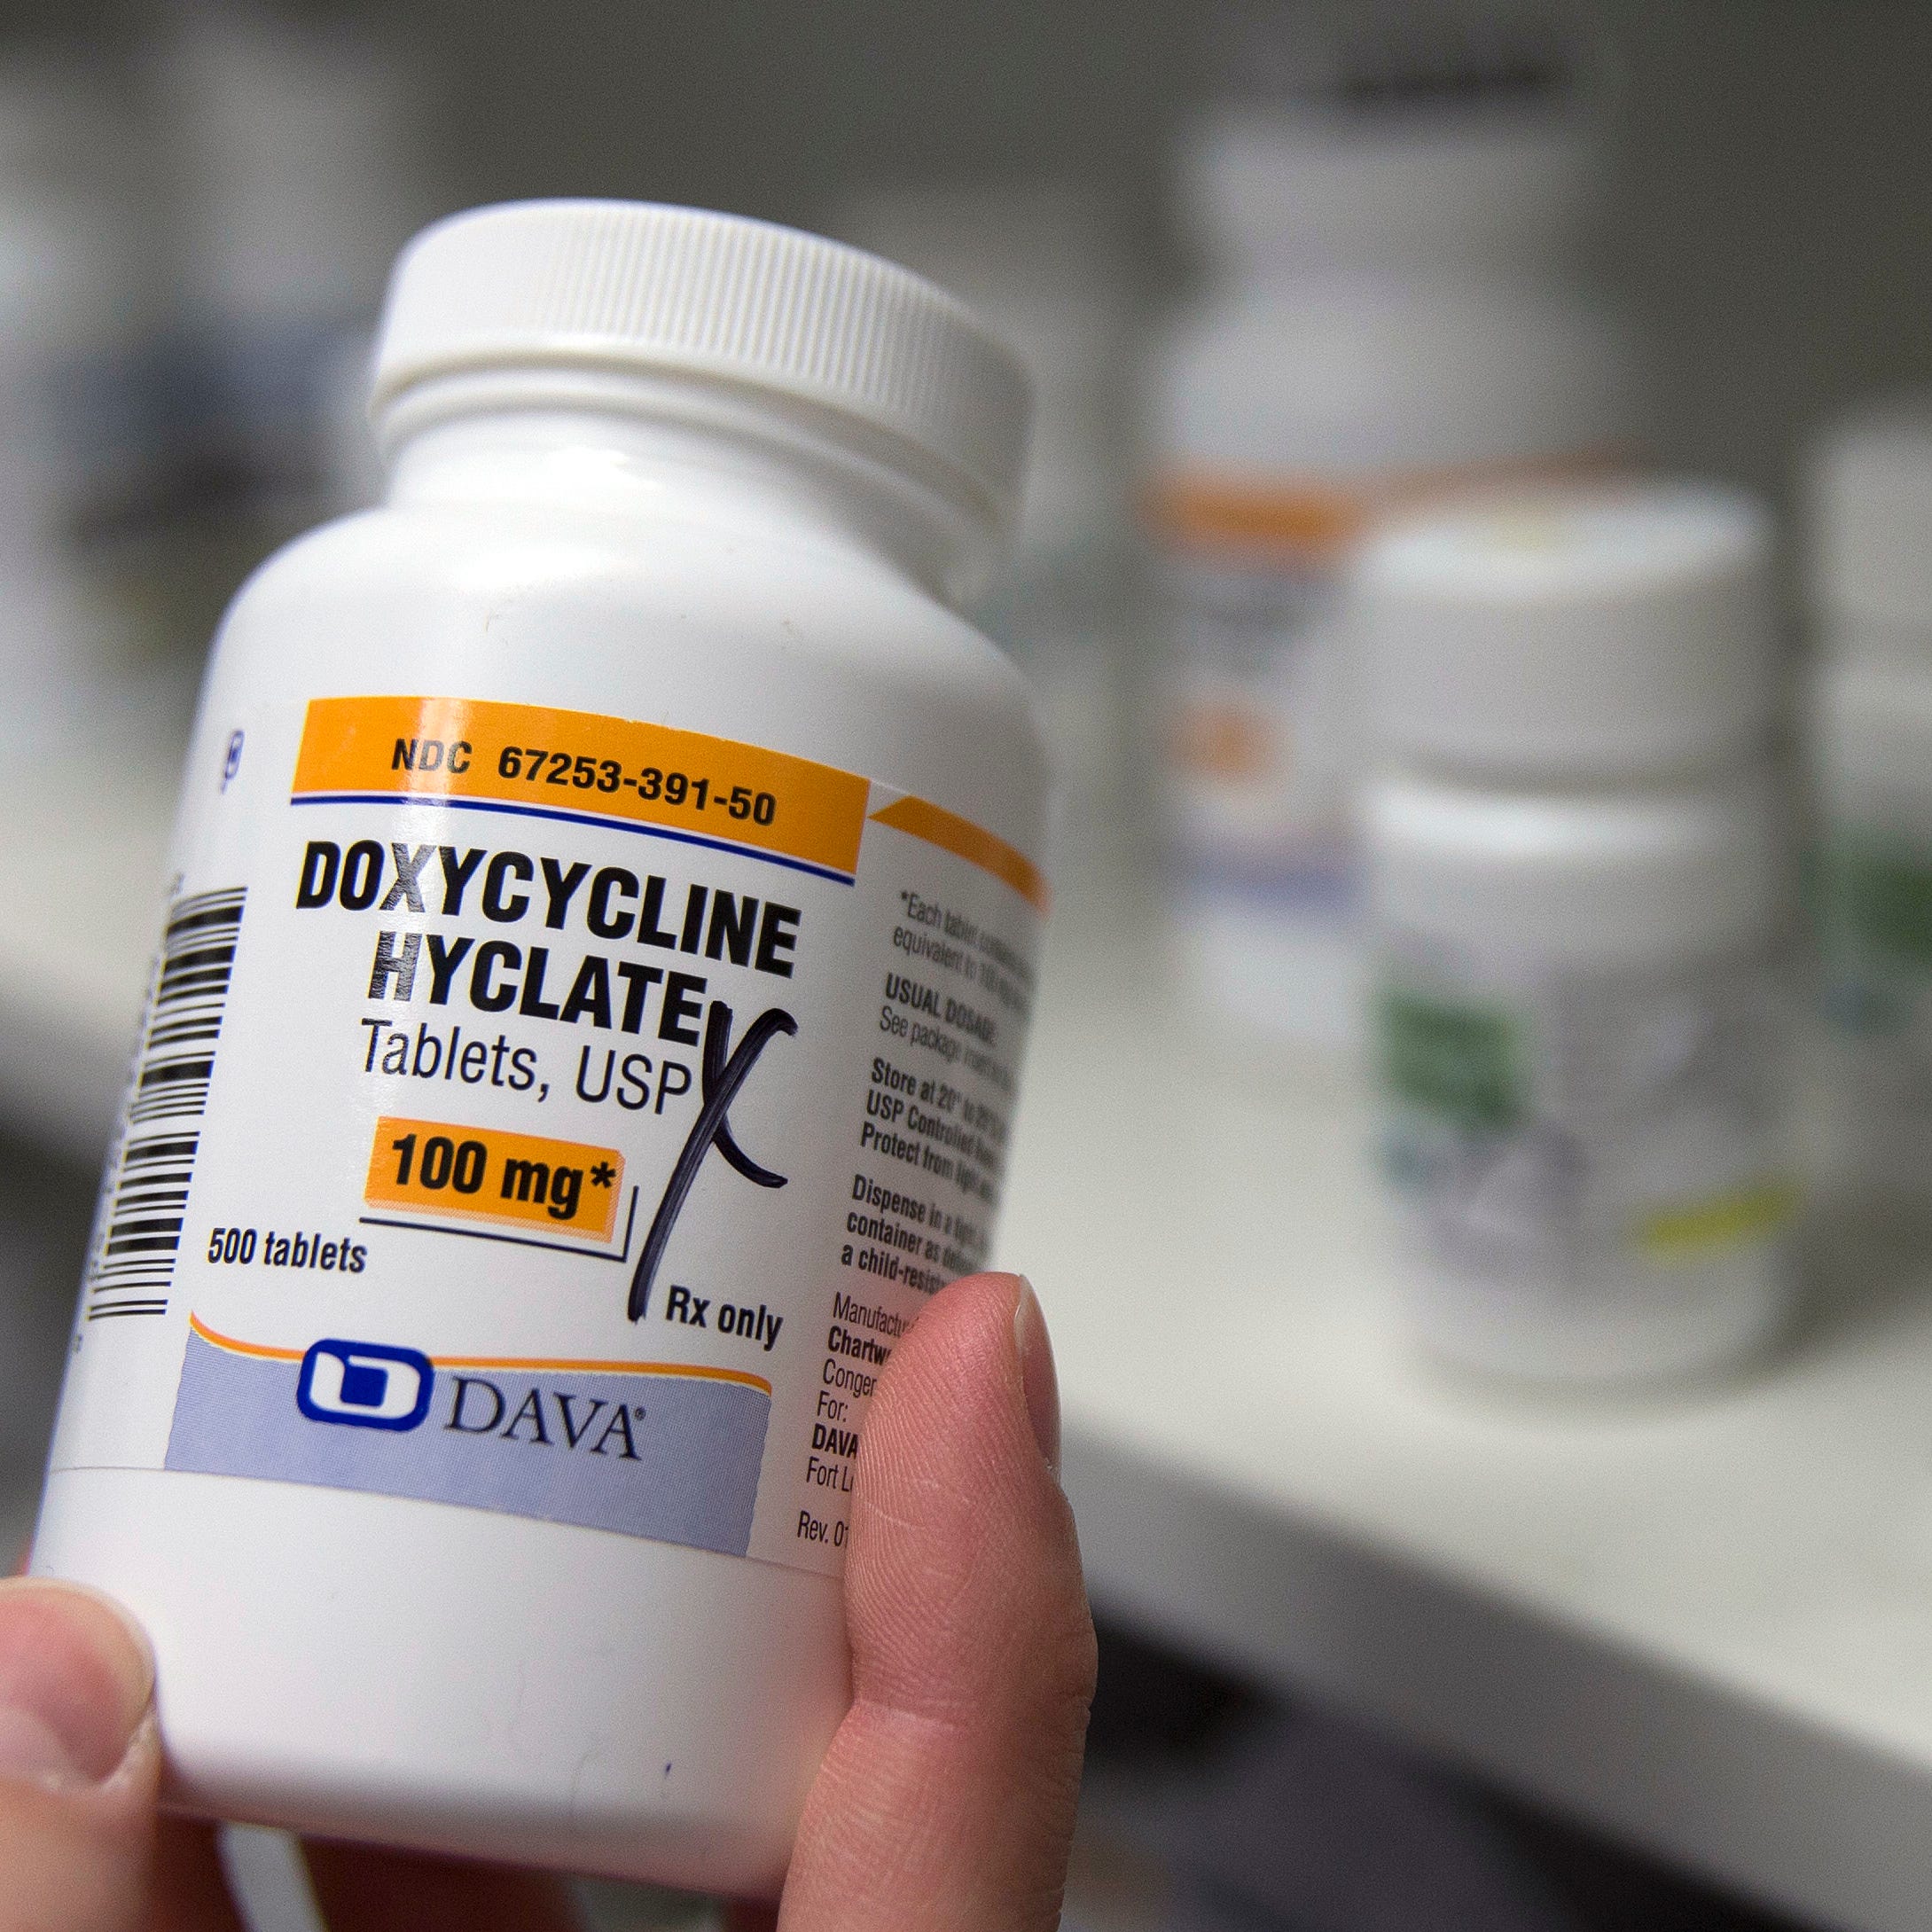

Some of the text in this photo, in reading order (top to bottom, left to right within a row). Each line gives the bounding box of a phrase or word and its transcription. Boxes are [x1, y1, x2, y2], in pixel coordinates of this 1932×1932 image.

[392, 739, 777, 826] NDC 67253-391-50
[296, 840, 802, 979] DOXYCYCLINE
[367, 931, 708, 1046] HYCLATE
[886, 973, 942, 1019] USUAL
[880, 1005, 910, 1037] See
[360, 1017, 692, 1115] Tablets, USP
[872, 1057, 917, 1097] Store
[920, 1079, 935, 1105] at
[866, 1089, 905, 1124] USP
[392, 1134, 488, 1194] 100
[860, 1121, 921, 1167] Protect
[852, 1173, 927, 1222] Dispense
[207, 1227, 367, 1273] 500 tablets
[841, 1243, 854, 1266] a
[846, 1211, 924, 1256] container
[666, 1285, 784, 1351] Rx only
[833, 1292, 906, 1338] Manufactu
[827, 1325, 890, 1366] Chartw
[823, 1357, 877, 1398] Conger
[817, 1390, 849, 1422] For:
[811, 1422, 858, 1460] DAVA
[806, 1456, 839, 1488] Fort
[797, 1510, 828, 1545] Rev.
